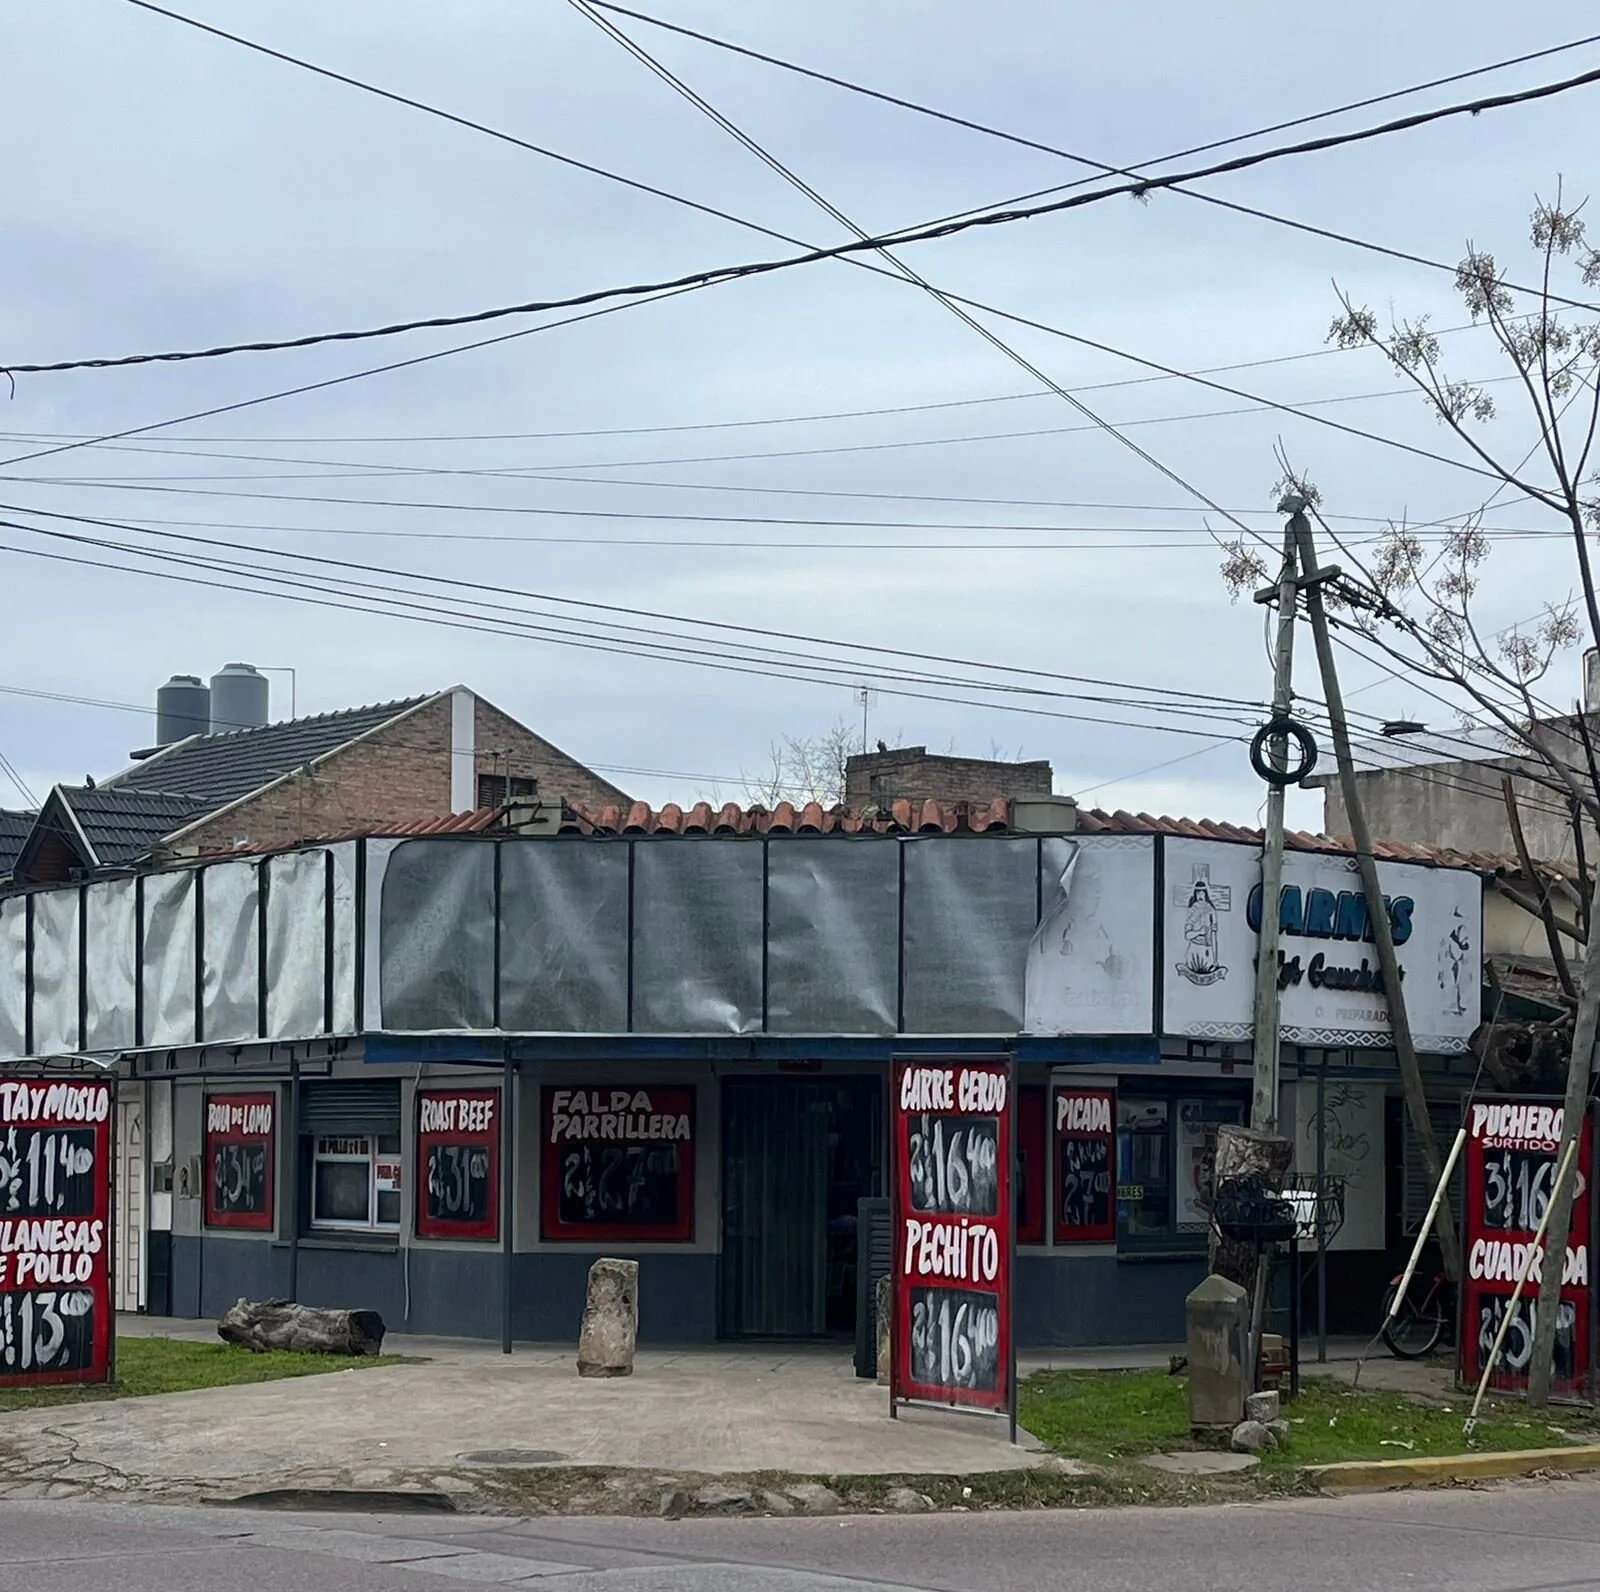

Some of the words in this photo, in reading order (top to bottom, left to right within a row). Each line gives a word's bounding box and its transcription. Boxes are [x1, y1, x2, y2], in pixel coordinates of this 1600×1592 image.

[552, 1090, 653, 1114] FALDA
[900, 1066, 954, 1110] CARRE
[958, 1068, 1006, 1112] CERDO
[207, 1103, 230, 1134] BOLA
[231, 1107, 243, 1126] DE
[242, 1104, 272, 1135] LOMO
[420, 1099, 457, 1133] ROAST
[459, 1098, 494, 1132] BEEF
[1056, 1095, 1112, 1134] PICADA
[1482, 1137, 1556, 1151] SURTIDO
[1485, 1162, 1506, 1210] 3
[17, 1252, 93, 1285] POLLO
